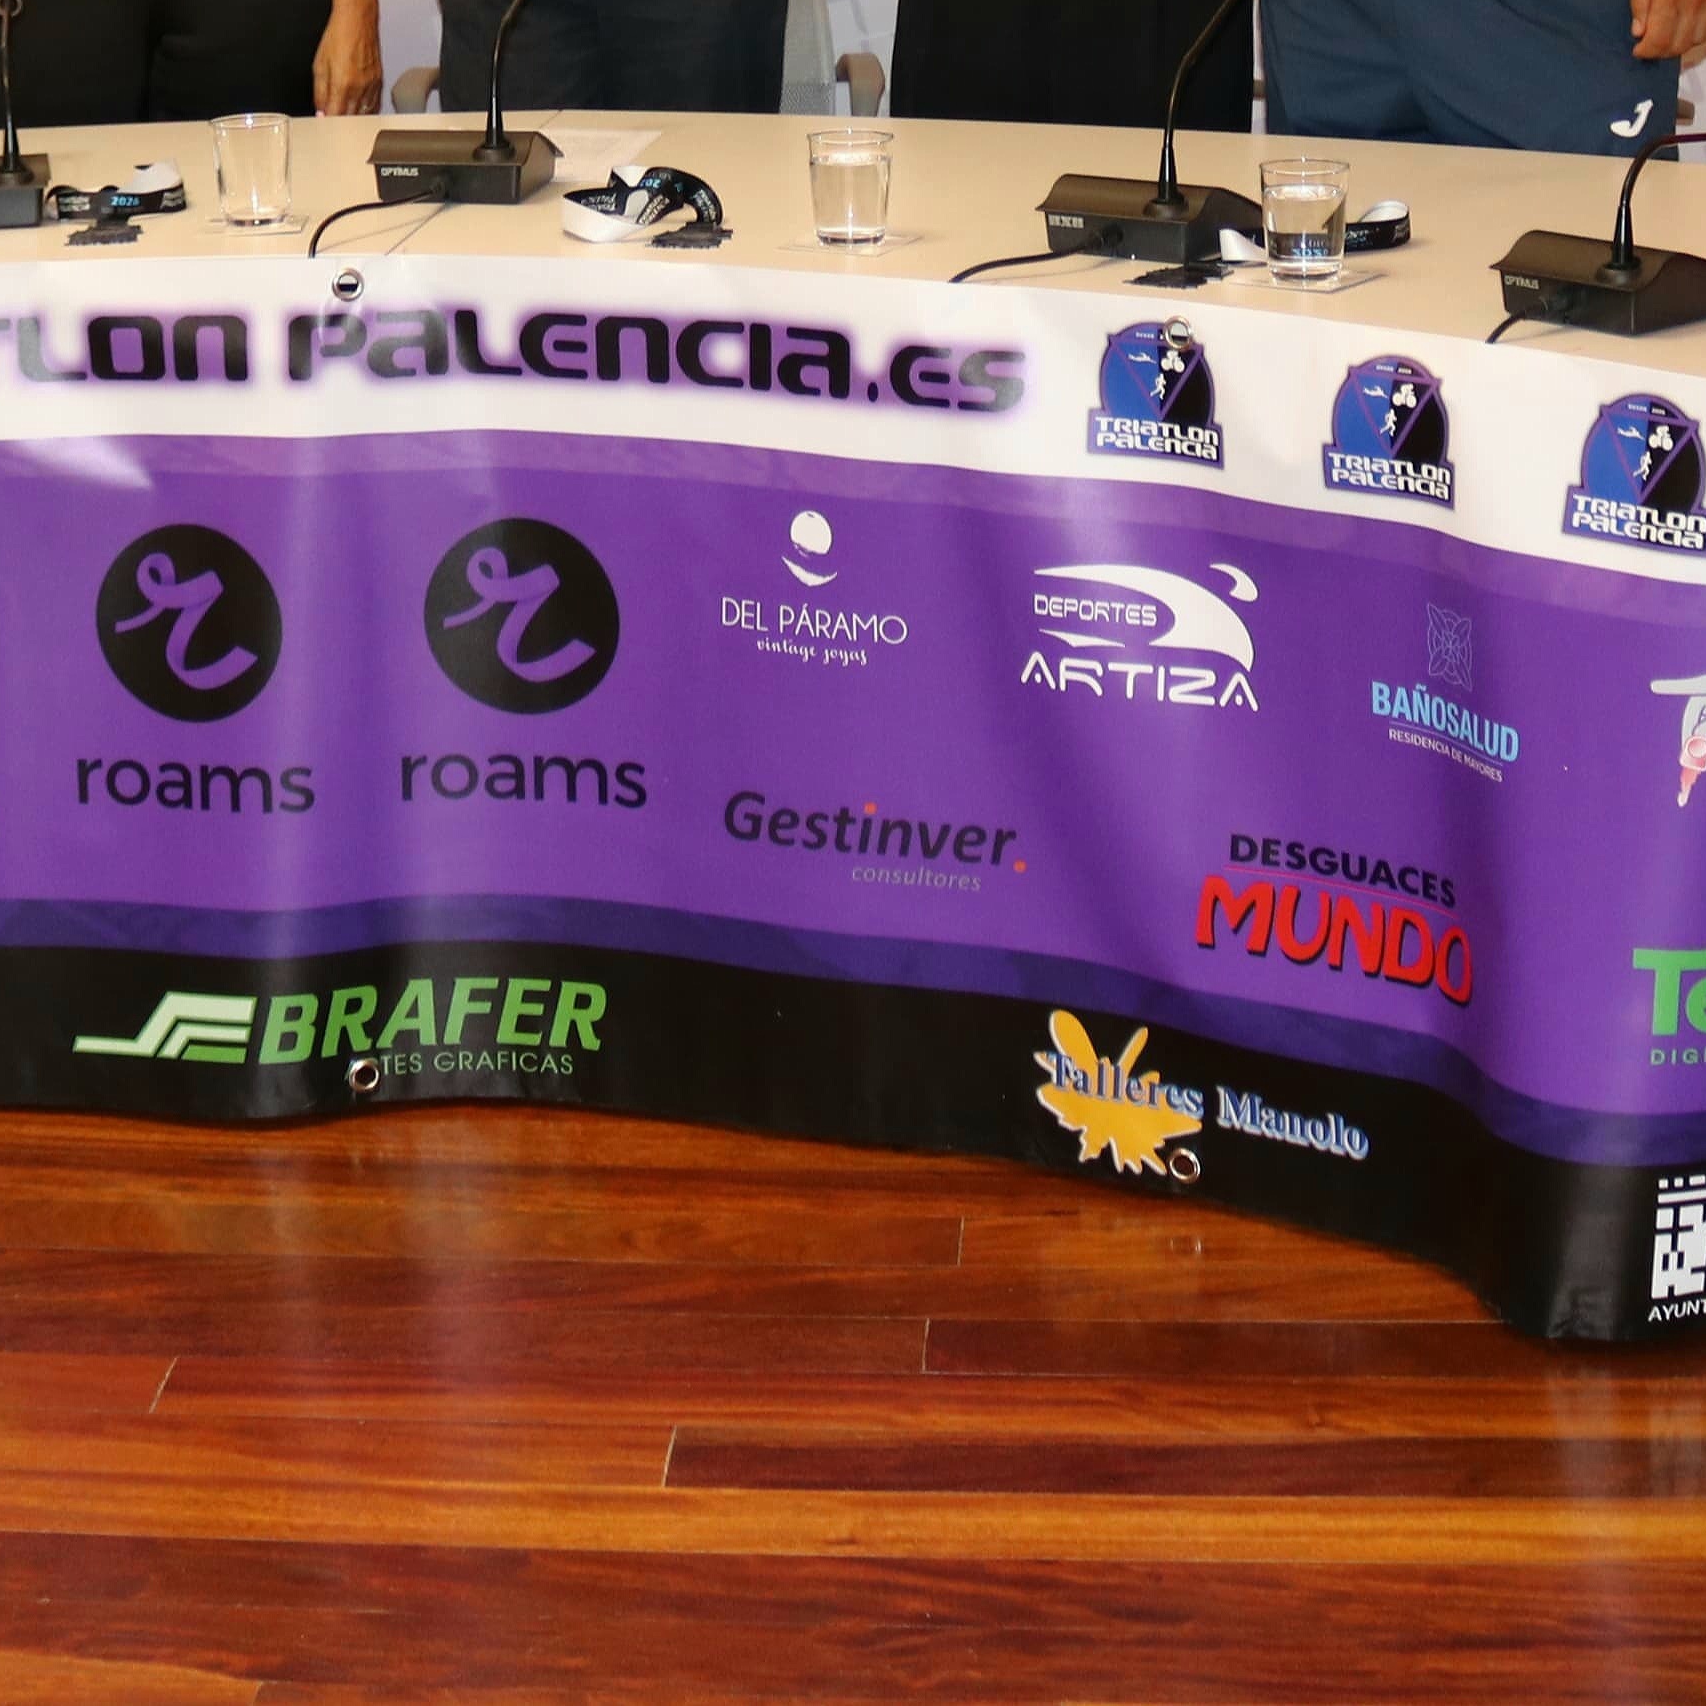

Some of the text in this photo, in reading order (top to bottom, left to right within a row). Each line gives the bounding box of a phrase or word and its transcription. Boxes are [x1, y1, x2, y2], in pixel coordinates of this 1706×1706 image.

[722, 597, 908, 645] DEL PÁRAMO
[1034, 594, 1157, 628] DEPORTES
[756, 636, 867, 666] vintage joyas
[1020, 651, 1259, 712] ARTIZA
[1371, 680, 1520, 763] BAÑOSALUD
[77, 755, 315, 815] roams
[401, 753, 647, 809] roams
[1389, 728, 1503, 782] RESIDENCIA DE MAYORES
[723, 791, 1027, 875] Gestinver.
[851, 863, 982, 893] consultores
[1230, 833, 1457, 908] DESGUACES
[1195, 874, 1473, 1006] MUNDO
[258, 977, 608, 1065] BRAFER
[433, 1051, 574, 1076] GRAFICAS
[1046, 1051, 1370, 1160] Talleres Manolo
